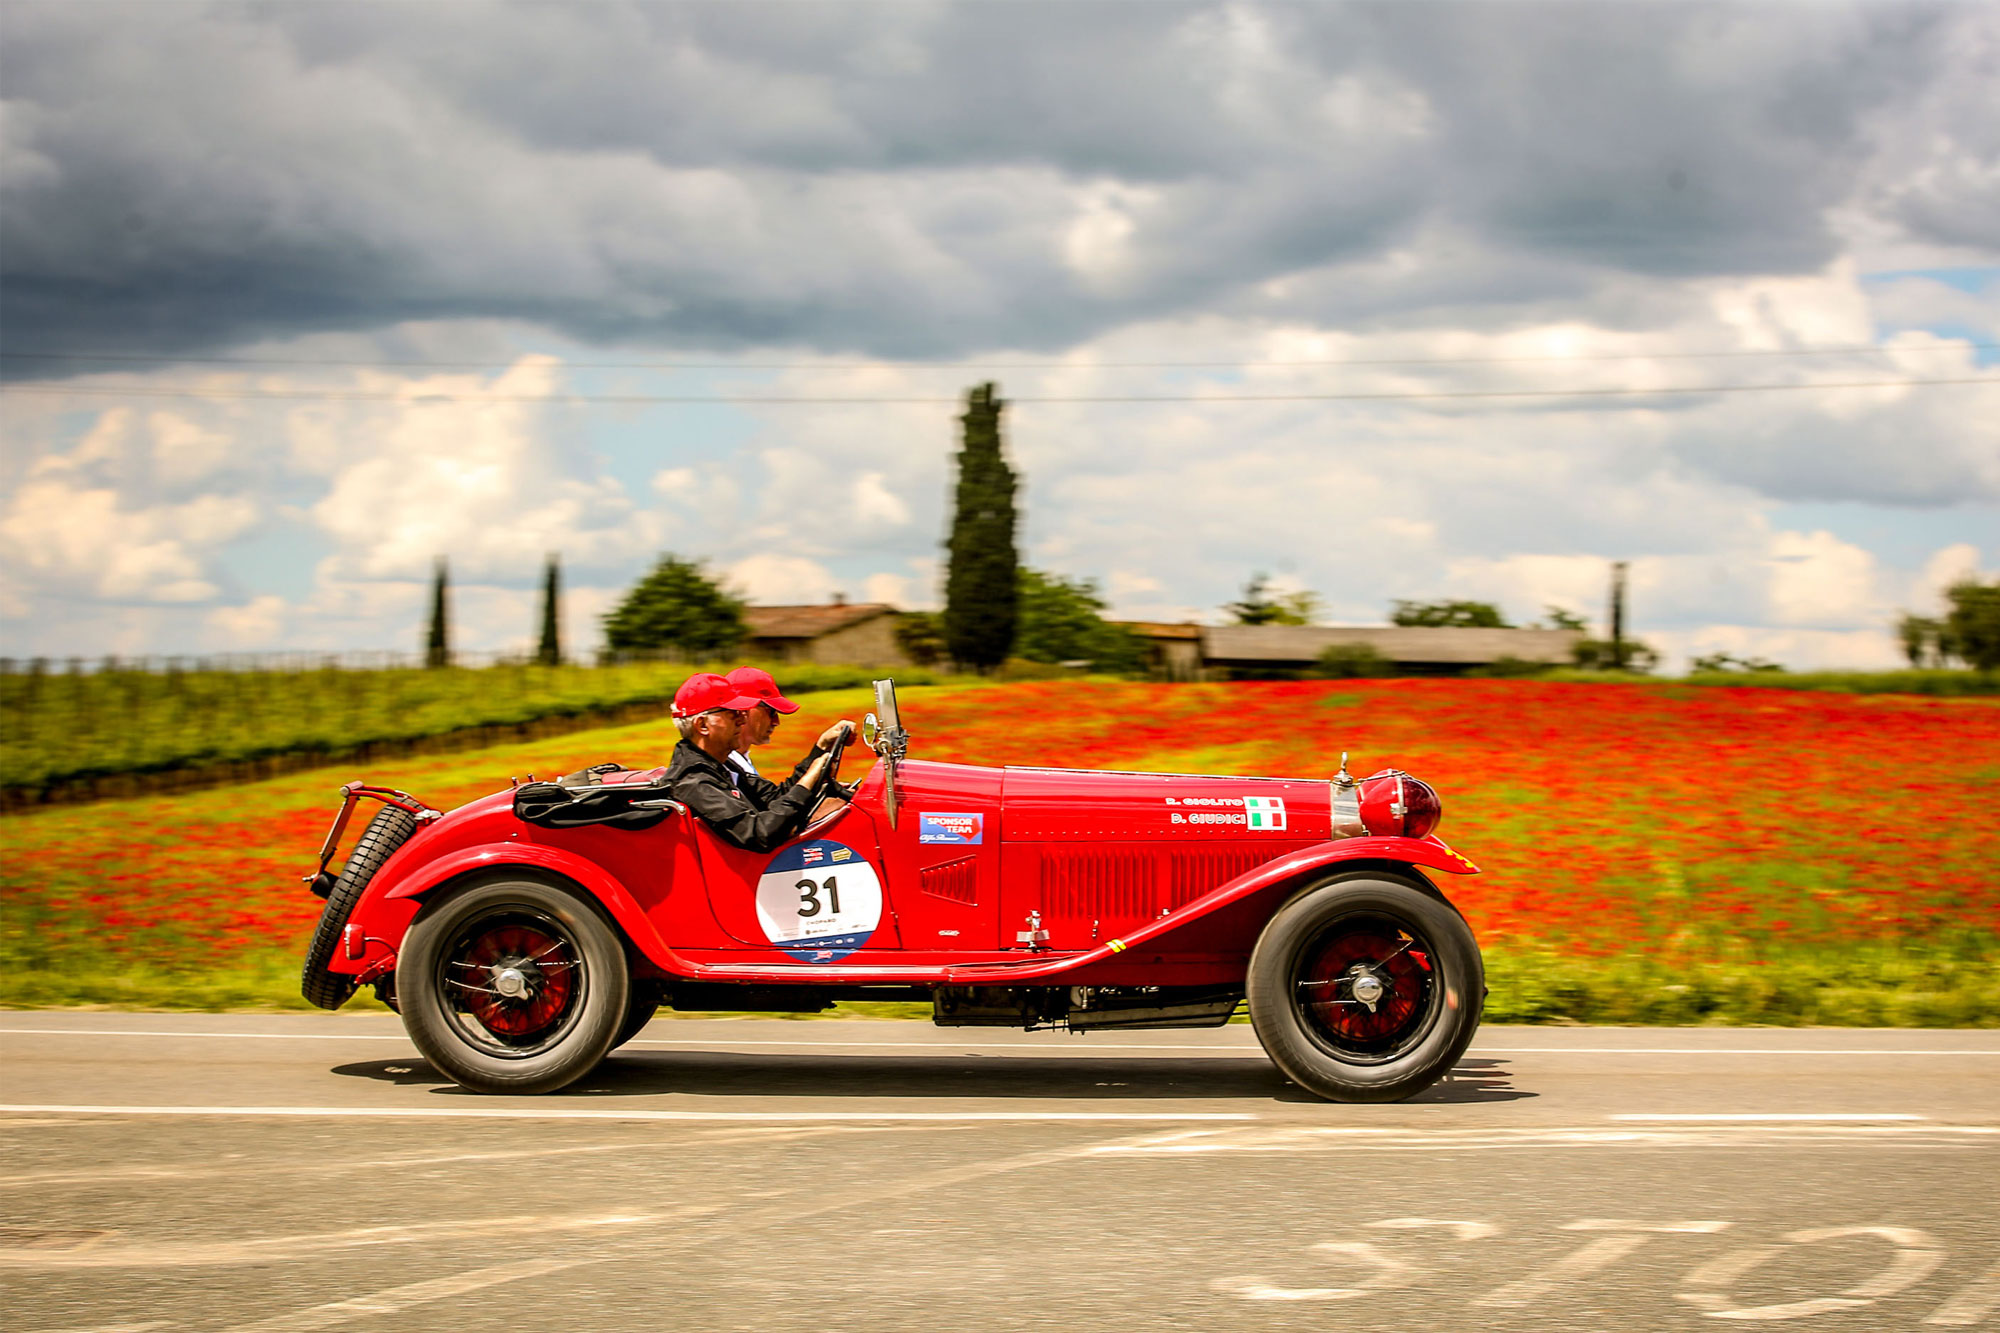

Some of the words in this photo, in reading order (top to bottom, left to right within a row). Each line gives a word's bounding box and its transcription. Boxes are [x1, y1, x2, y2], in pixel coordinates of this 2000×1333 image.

[1165, 797, 1181, 805] R.
[1183, 798, 1243, 806] GIOLITO
[927, 817, 973, 826] SPONSOR
[1171, 813, 1187, 824] D.
[1189, 813, 1246, 825] GIUDICI
[946, 825, 973, 834] TEAM
[795, 876, 840, 917] 31
